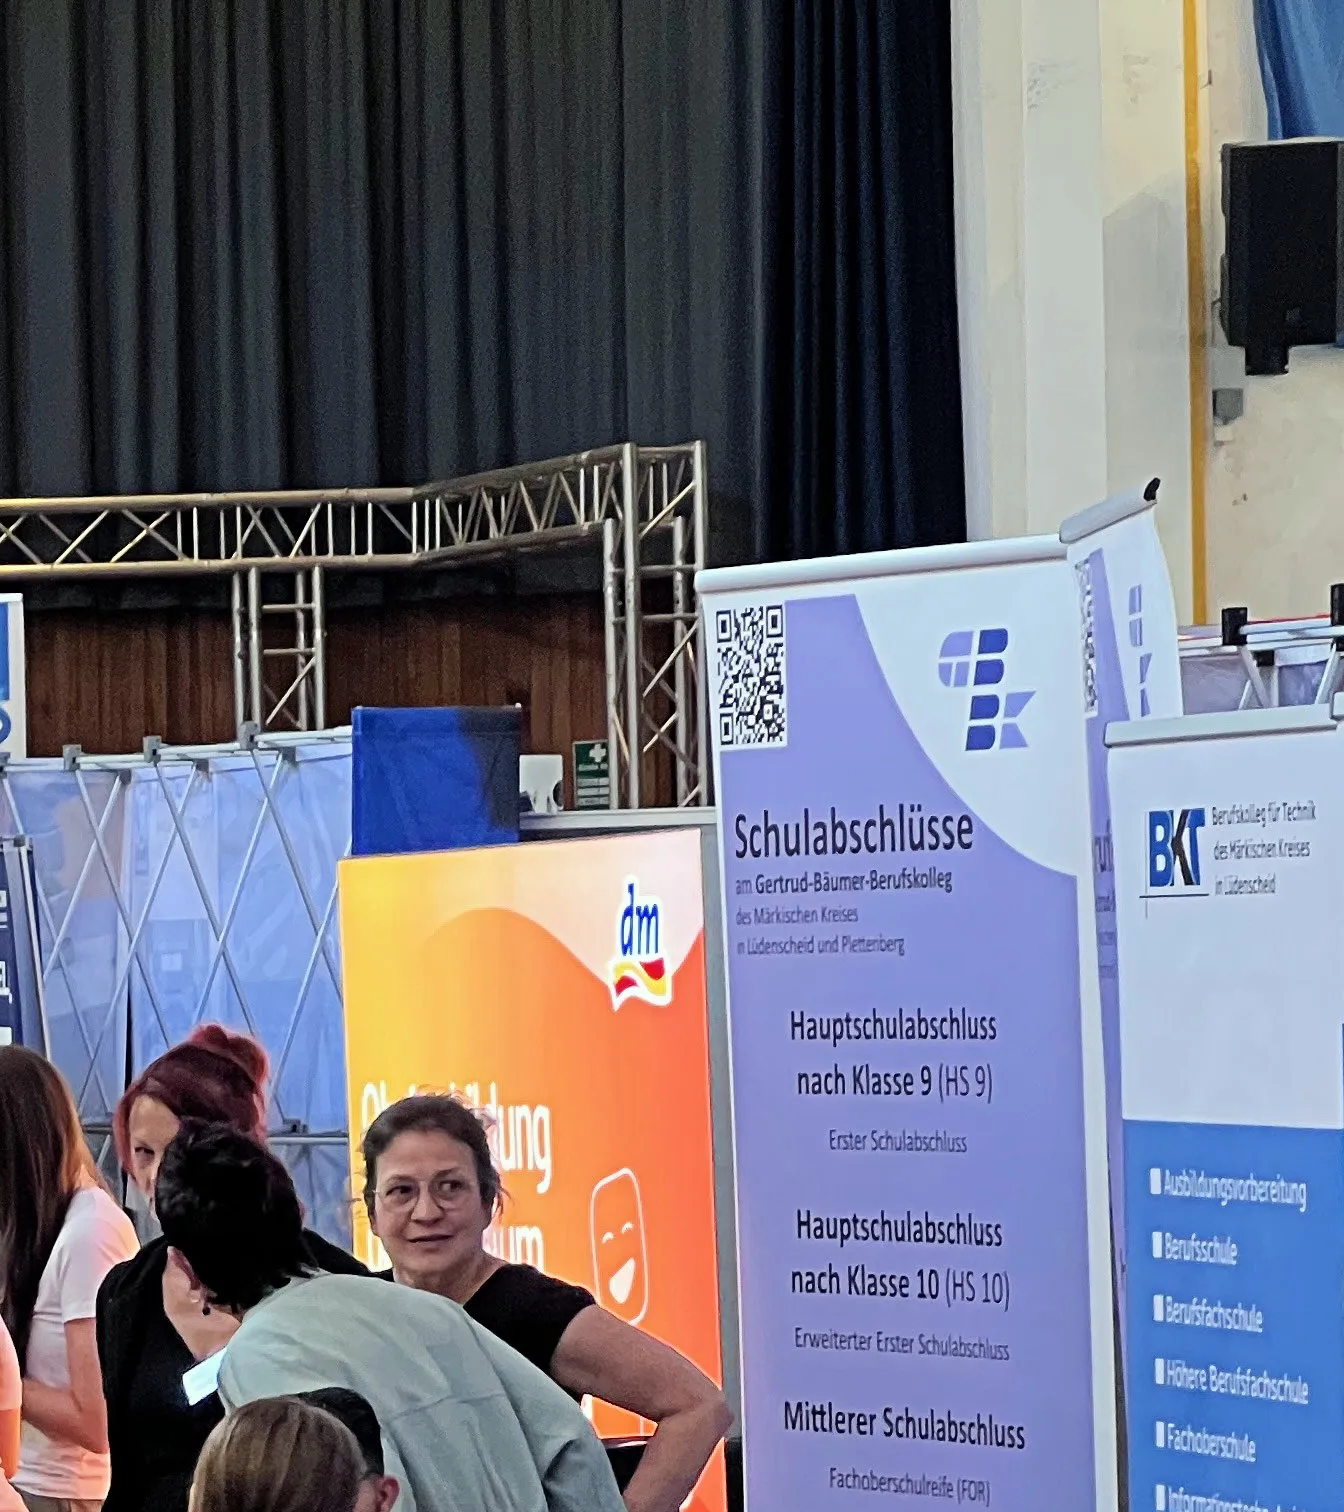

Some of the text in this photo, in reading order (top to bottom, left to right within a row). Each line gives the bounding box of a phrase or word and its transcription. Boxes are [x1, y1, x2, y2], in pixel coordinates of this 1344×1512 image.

[735, 803, 973, 859] Schulabschlüsse
[1149, 807, 1206, 888] BKT
[736, 867, 953, 895] am Gertrud-Bäumer-Berufskolleg
[620, 884, 659, 956] dm
[736, 906, 858, 926] des Märkischen Kreises
[747, 936, 815, 955] Lüdenscheid
[818, 936, 839, 953] und
[841, 933, 904, 956] Plettenberg
[790, 1007, 997, 1047] Hauptschulabschluss
[797, 1063, 994, 1104] nach Klasse 9 (HS 9)
[829, 1129, 968, 1153] Erster Schulabschluss
[1164, 1168, 1307, 1213] Ausbildungsvorbereitung
[796, 1209, 1003, 1247] Hauptschulabschluss
[1165, 1232, 1238, 1265] Berufsschule
[791, 1263, 1010, 1312] nach Klasse 10 (HS 10)
[1166, 1295, 1263, 1333] Berufsfachschule
[795, 1327, 1010, 1362] Erweiterter Erster Schulabschluss
[1167, 1359, 1309, 1405] Höhere Berufsfachschule
[784, 1400, 1025, 1450] Mittlerer Schulabschluss
[1167, 1422, 1256, 1462] Fachoberschule
[829, 1467, 991, 1507] Fachoberschulreife (FOR)
